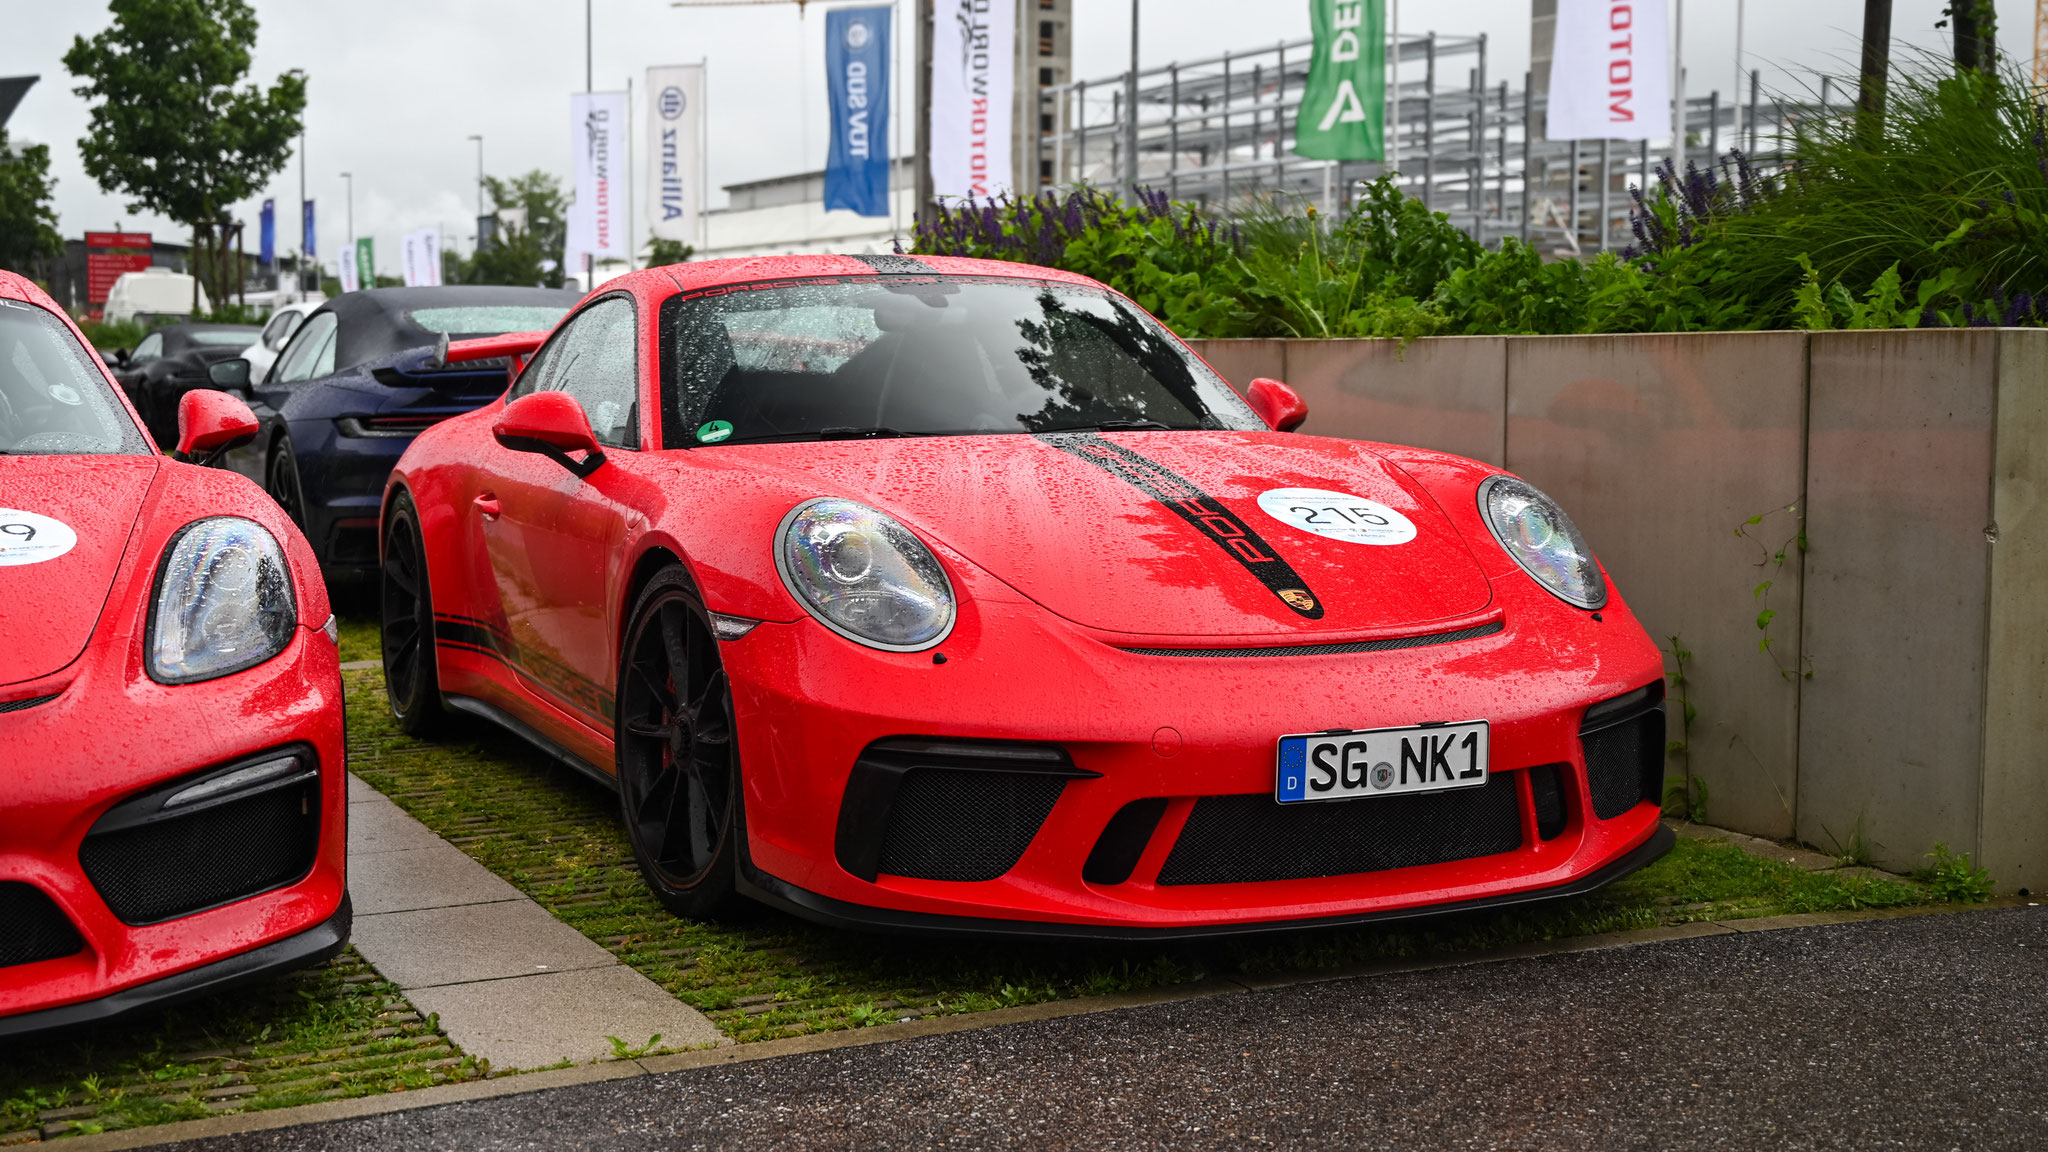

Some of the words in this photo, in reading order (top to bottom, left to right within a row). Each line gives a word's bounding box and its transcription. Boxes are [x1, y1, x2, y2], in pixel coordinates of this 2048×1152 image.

[682, 278, 840, 302] PORSCHE
[708, 421, 720, 432] 4
[1289, 506, 1390, 526] 215
[1309, 741, 1368, 792] SG
[1400, 731, 1483, 784] NK1
[1287, 776, 1297, 790] D
